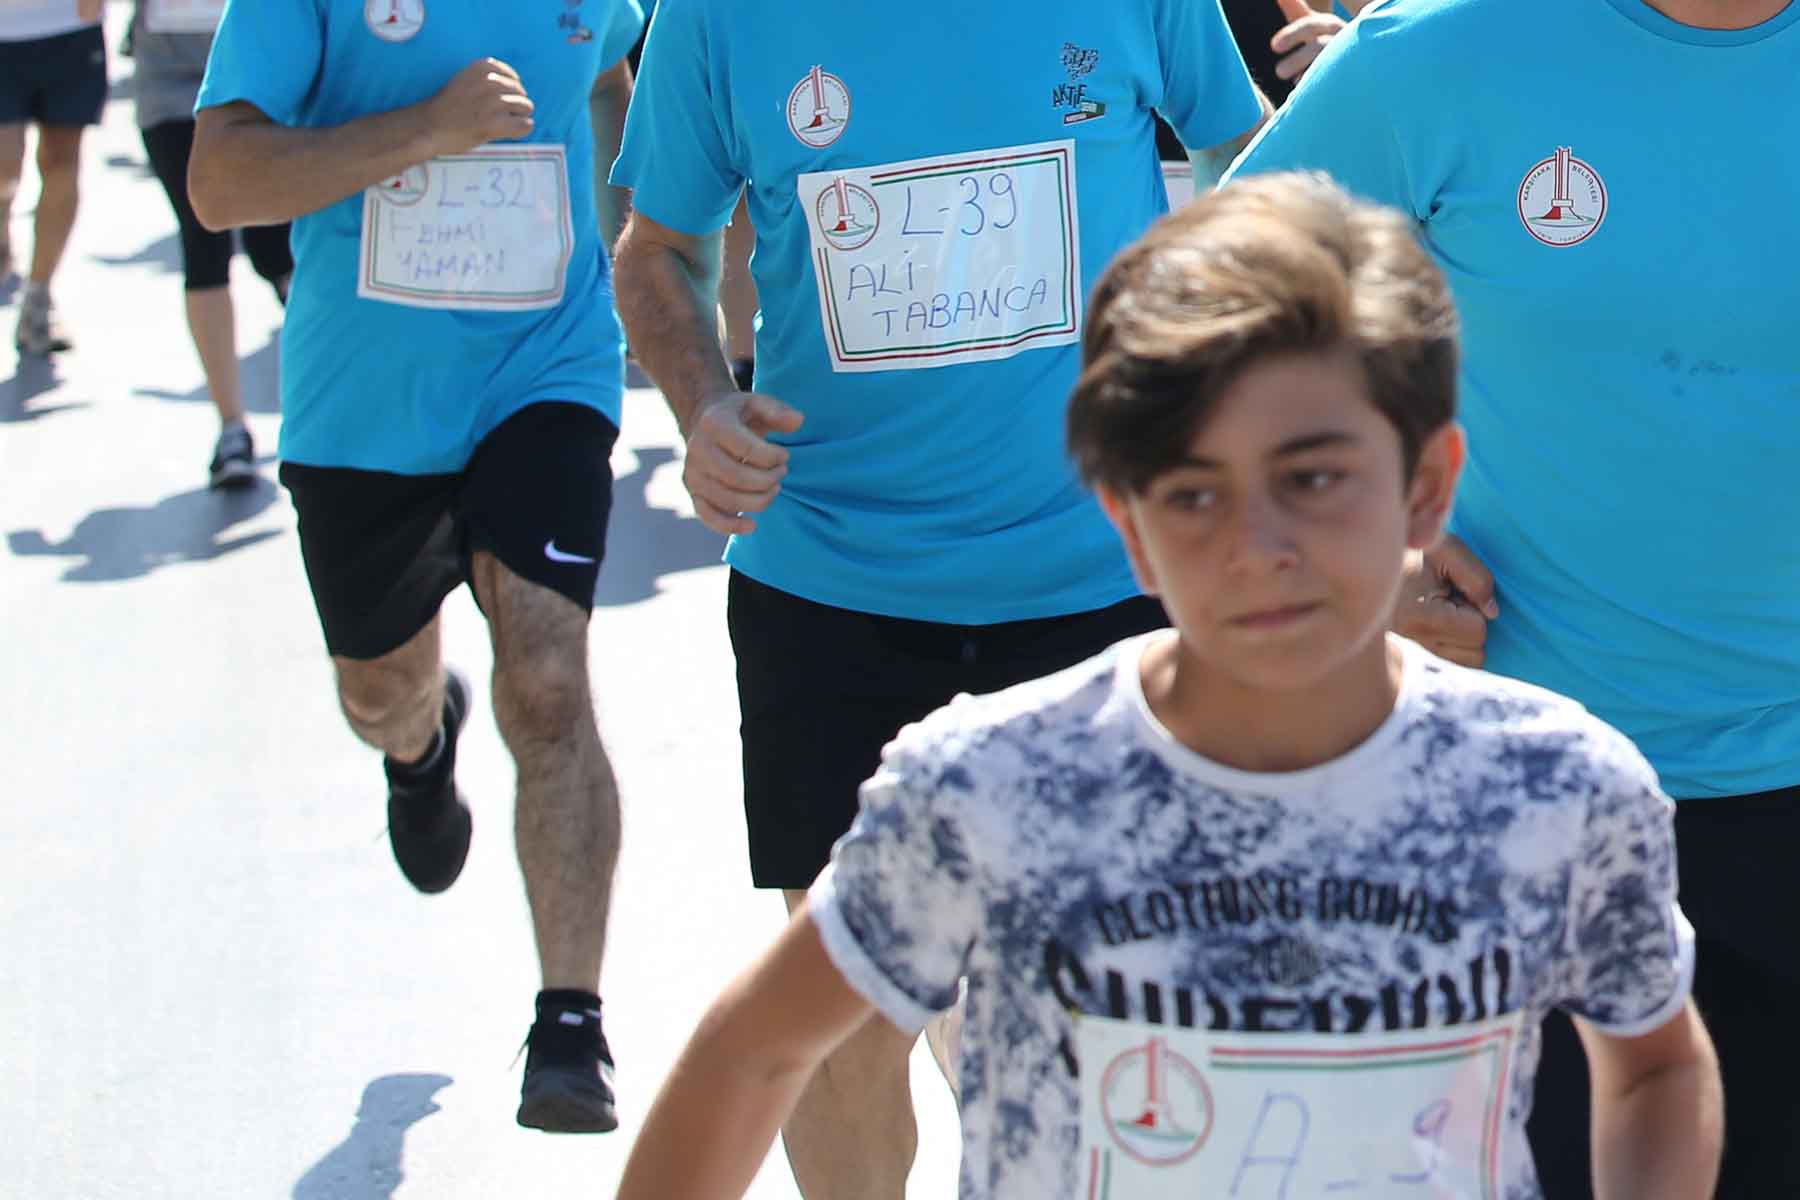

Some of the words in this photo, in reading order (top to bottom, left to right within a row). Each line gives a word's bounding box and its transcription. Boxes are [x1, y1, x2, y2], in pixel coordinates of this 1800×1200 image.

[901, 172, 1018, 236] L-39
[872, 278, 1048, 337] TABANCA
[1100, 878, 1300, 946] CLOTHING
